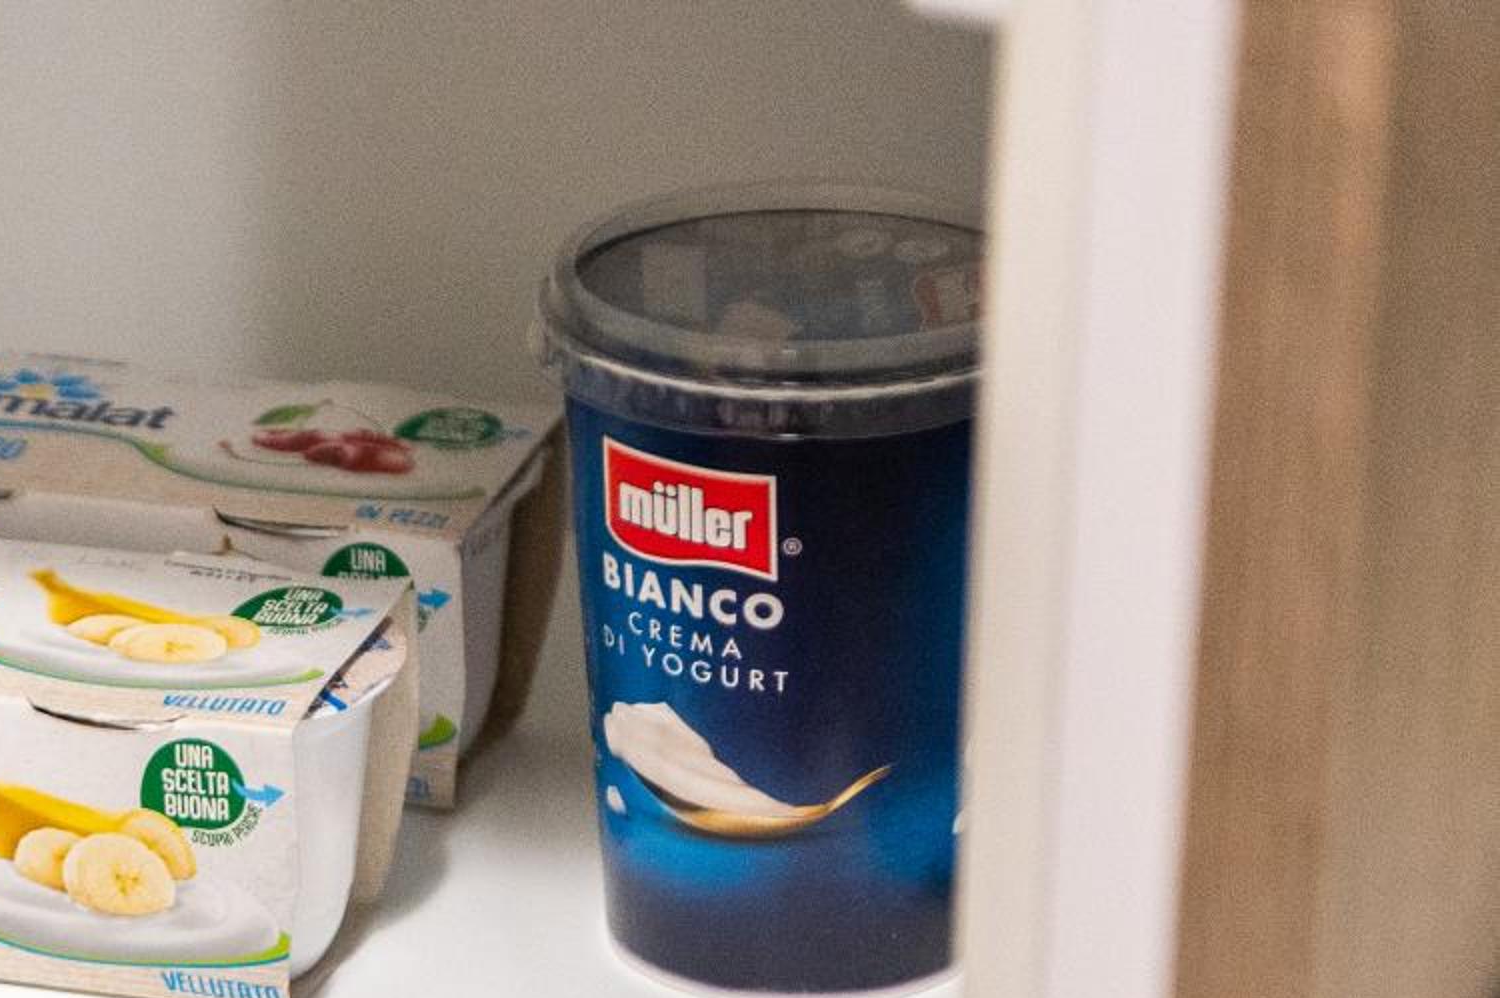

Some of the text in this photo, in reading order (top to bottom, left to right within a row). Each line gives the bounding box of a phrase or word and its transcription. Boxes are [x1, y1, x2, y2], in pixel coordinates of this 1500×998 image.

[618, 480, 753, 550] müller
[351, 549, 387, 574] UNA
[603, 550, 785, 629] BIANCO
[253, 610, 320, 625] BUONA
[261, 599, 329, 614] SCELTA
[627, 611, 743, 660] CREMA
[603, 623, 789, 692] DI YOGURT
[163, 694, 288, 716] VELLUTATO
[174, 743, 214, 769] UNA
[161, 768, 230, 795] SCELTA
[164, 794, 230, 821] BUONA
